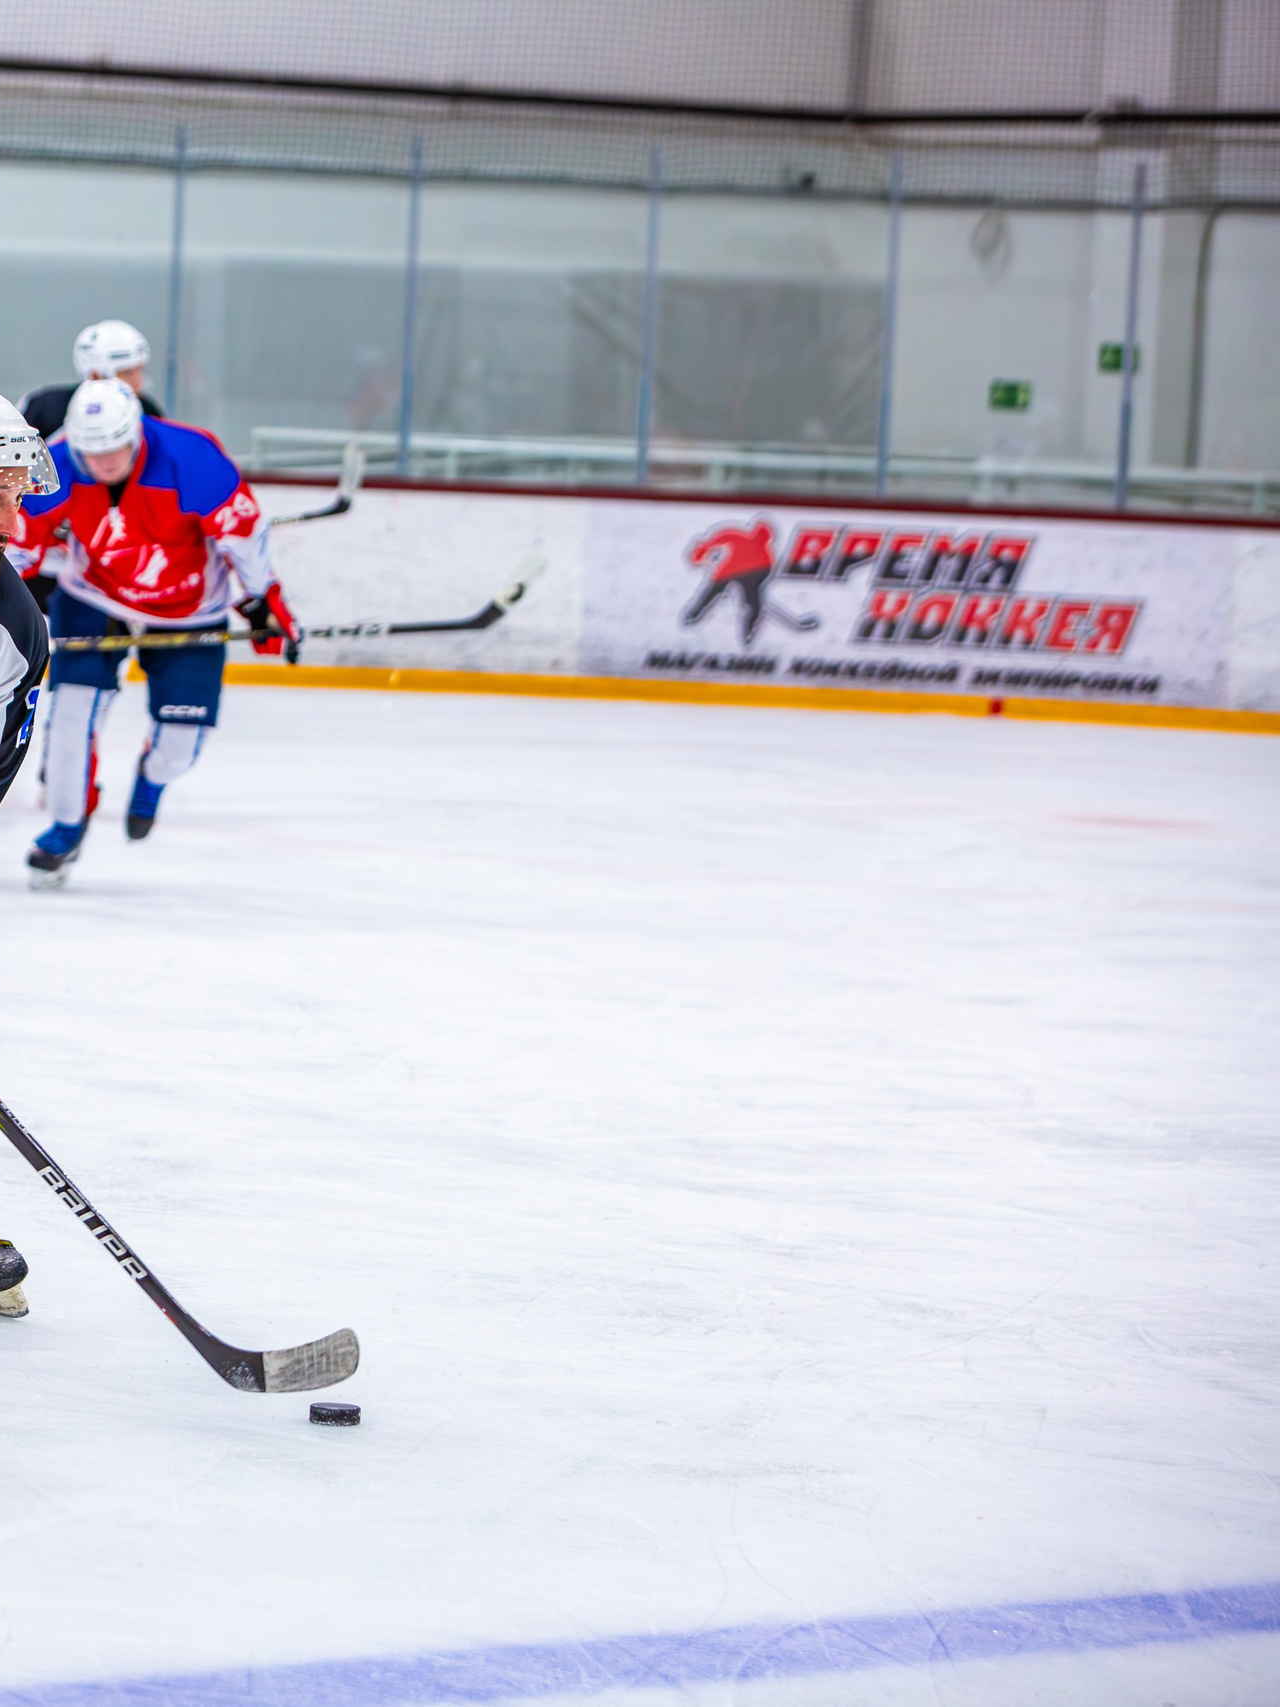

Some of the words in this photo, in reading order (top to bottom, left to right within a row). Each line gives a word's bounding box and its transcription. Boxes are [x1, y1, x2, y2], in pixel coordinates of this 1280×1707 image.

[10, 435, 37, 443] BAUR
[783, 528, 1033, 588] ВРЕМЯ
[856, 588, 1141, 654] ХОККЕЯ
[643, 651, 778, 674] МАГАЗИН
[786, 655, 960, 684] ХОККЕЙНОЙ
[158, 704, 209, 719] CCM
[37, 1165, 148, 1280] BAUER
